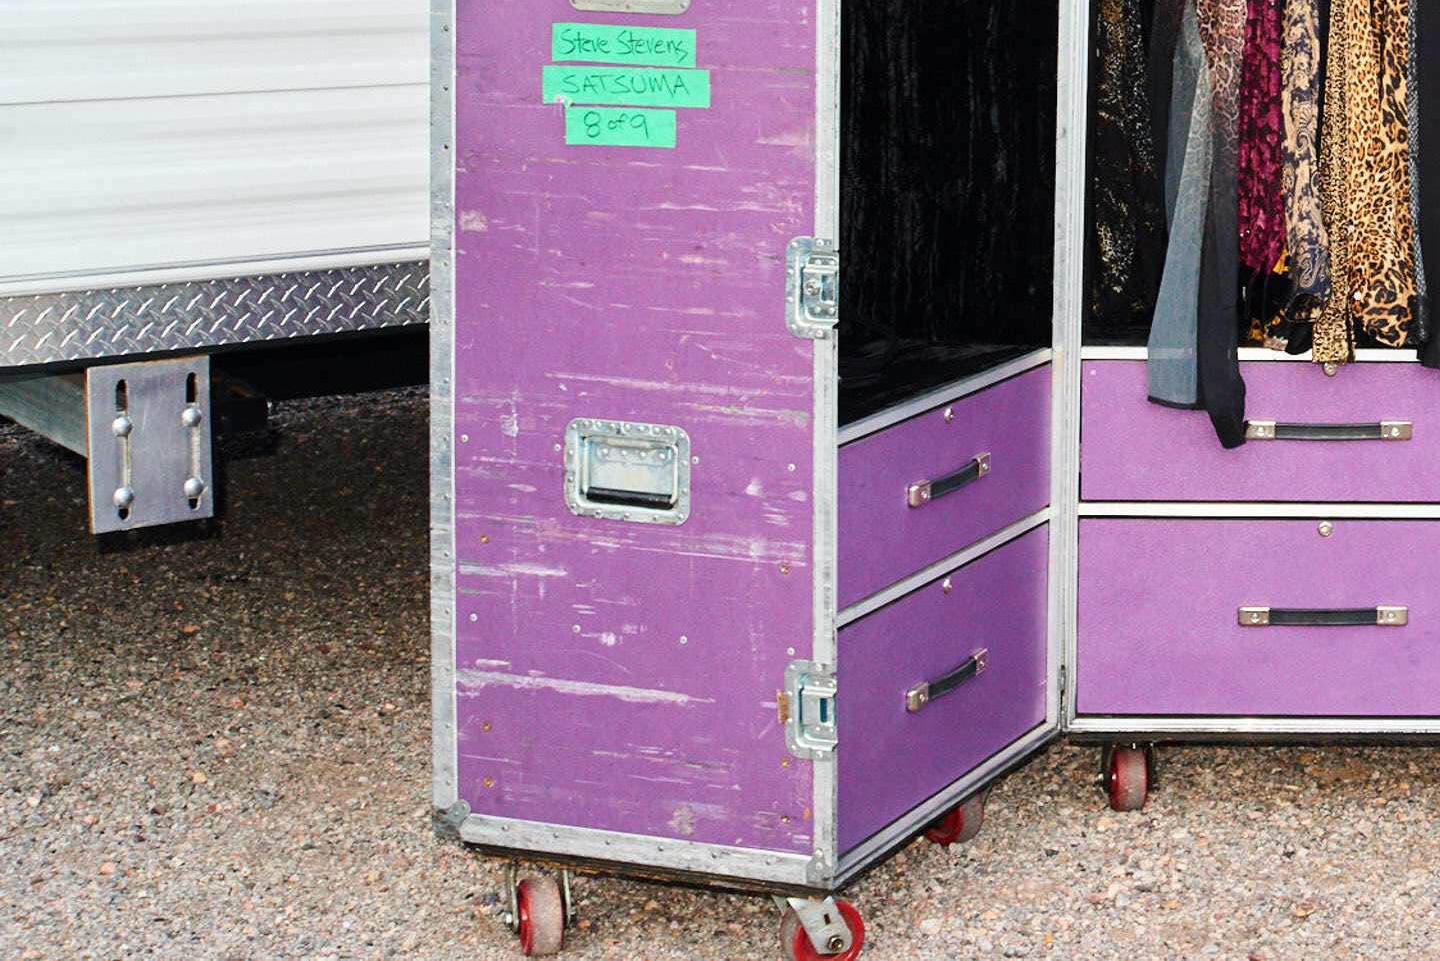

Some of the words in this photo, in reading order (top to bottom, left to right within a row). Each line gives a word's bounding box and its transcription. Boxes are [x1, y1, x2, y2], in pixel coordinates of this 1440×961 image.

[559, 28, 611, 55] Steve
[615, 30, 689, 63] Stevens
[561, 74, 690, 98] SATSUMA
[583, 110, 601, 138] 8
[607, 113, 629, 130] of
[630, 114, 649, 139] 9
